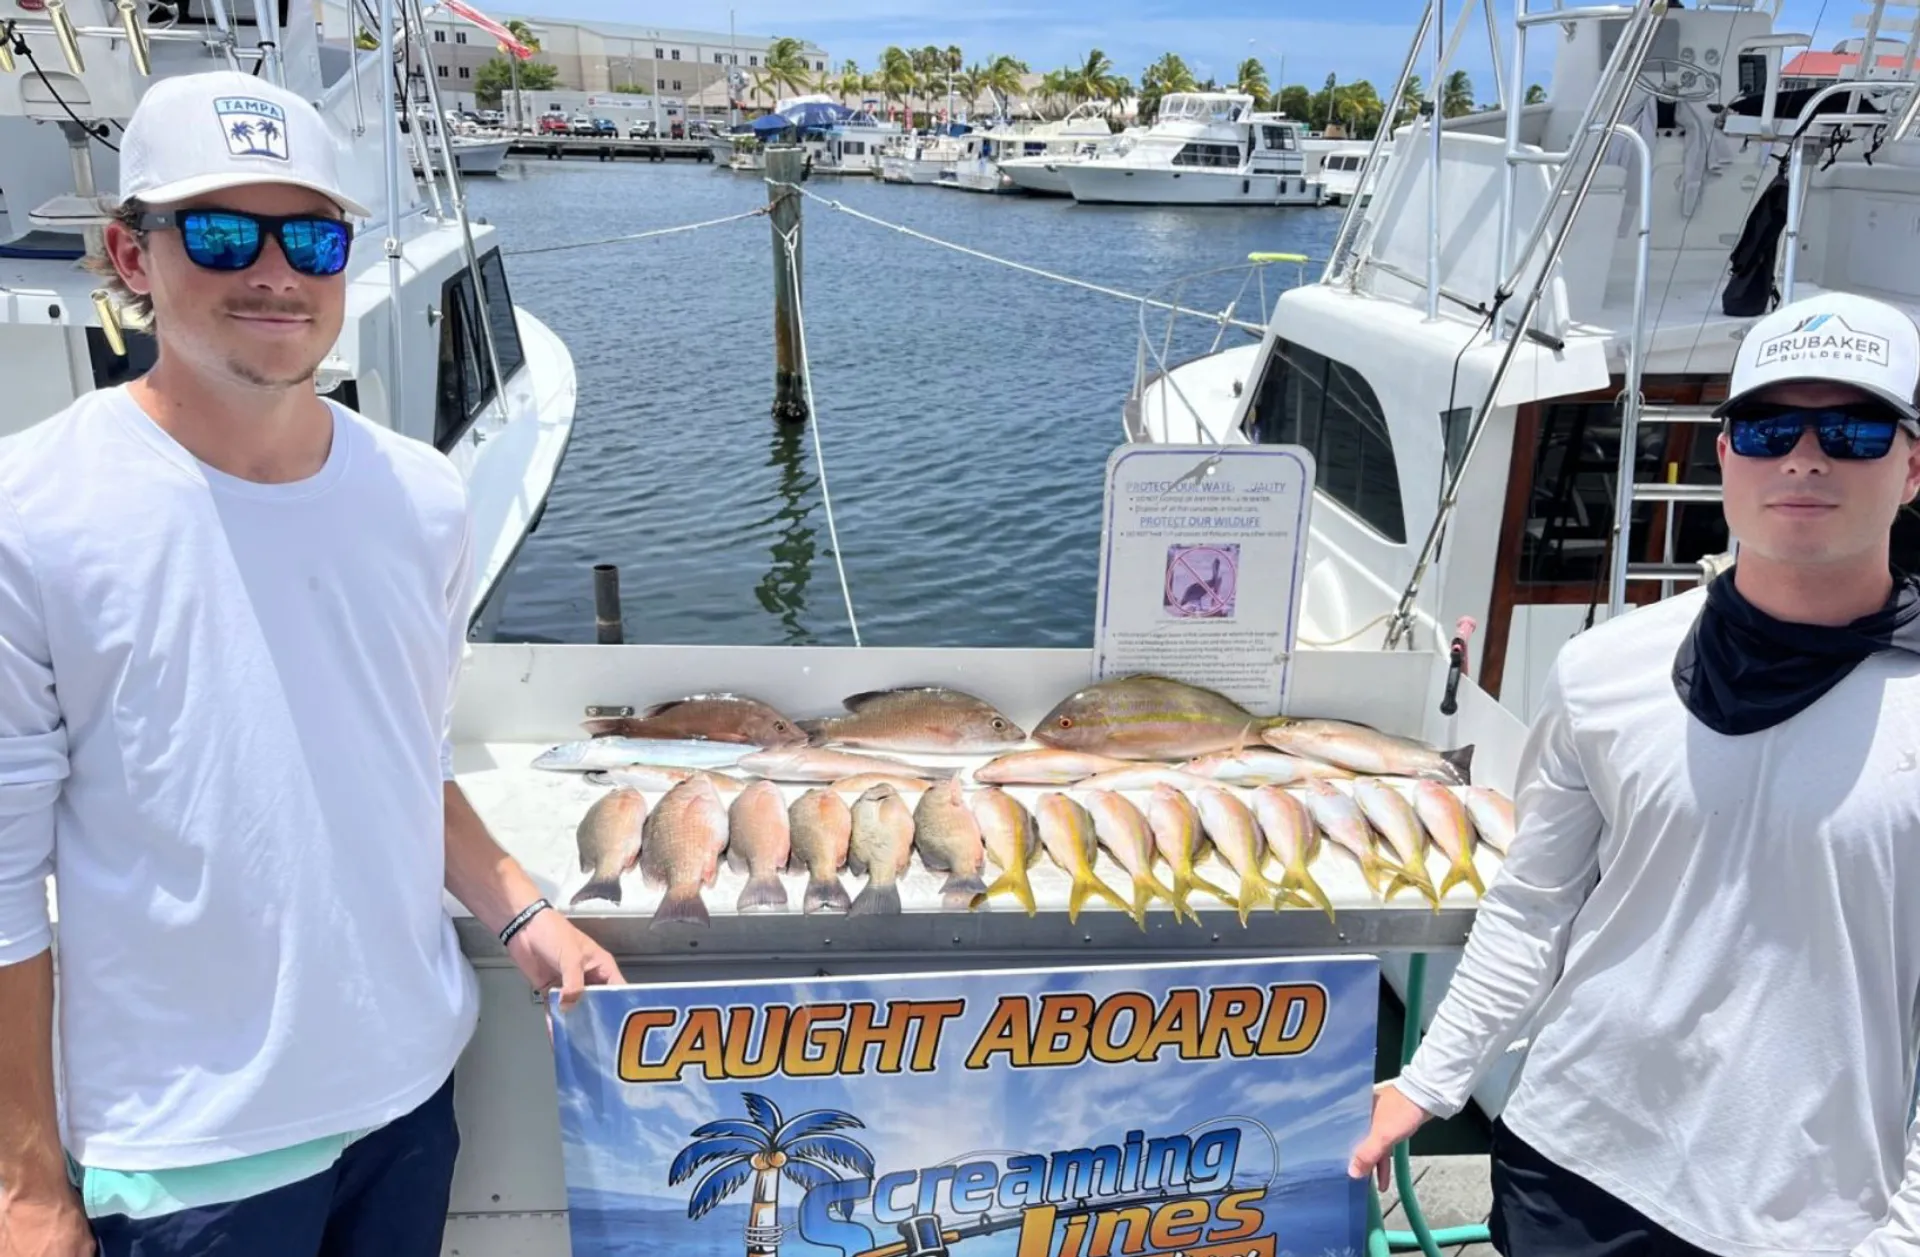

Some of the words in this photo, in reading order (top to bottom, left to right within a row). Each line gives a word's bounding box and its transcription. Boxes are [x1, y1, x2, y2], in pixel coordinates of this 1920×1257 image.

[224, 100, 279, 116] TAMPA
[1767, 335, 1880, 357] BRUBAKER
[1780, 351, 1863, 362] BUILDERS
[1125, 481, 1172, 493] PROTECT
[1243, 482, 1286, 493] UALITY
[1140, 516, 1186, 528] PROTECT
[1188, 516, 1211, 528] OUR
[1213, 516, 1260, 528] WILDLIFE
[617, 997, 966, 1082] CAUGHT
[964, 983, 1328, 1069] ABOARD
[798, 1126, 1242, 1257] Screaming
